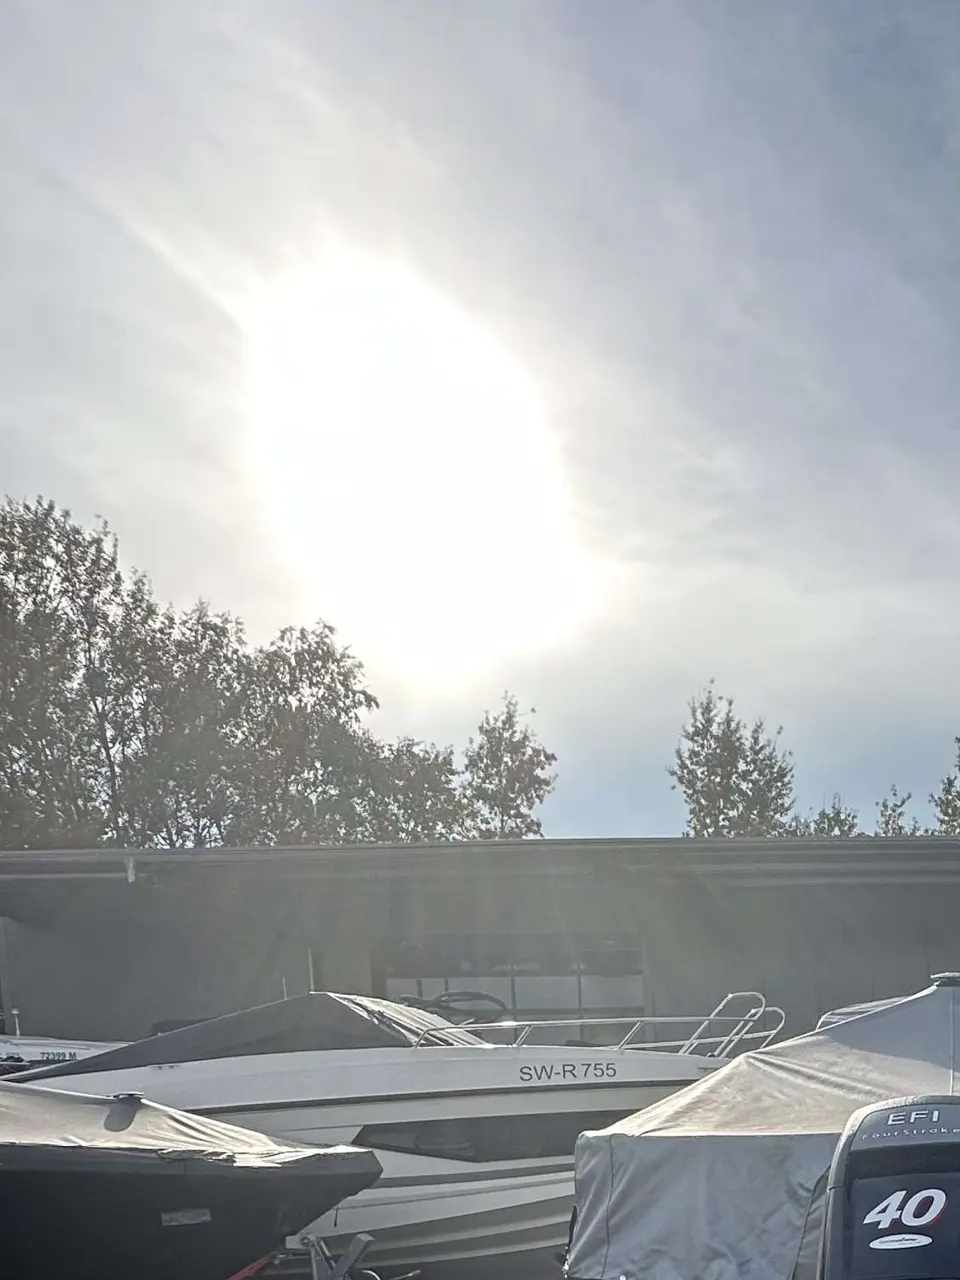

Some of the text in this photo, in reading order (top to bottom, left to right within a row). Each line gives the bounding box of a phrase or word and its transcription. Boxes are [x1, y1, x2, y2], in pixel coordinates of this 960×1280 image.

[69, 1052, 77, 1060] M
[519, 1062, 617, 1081] SW-R 755
[887, 1110, 940, 1125] EFI
[862, 1188, 947, 1229] 40
